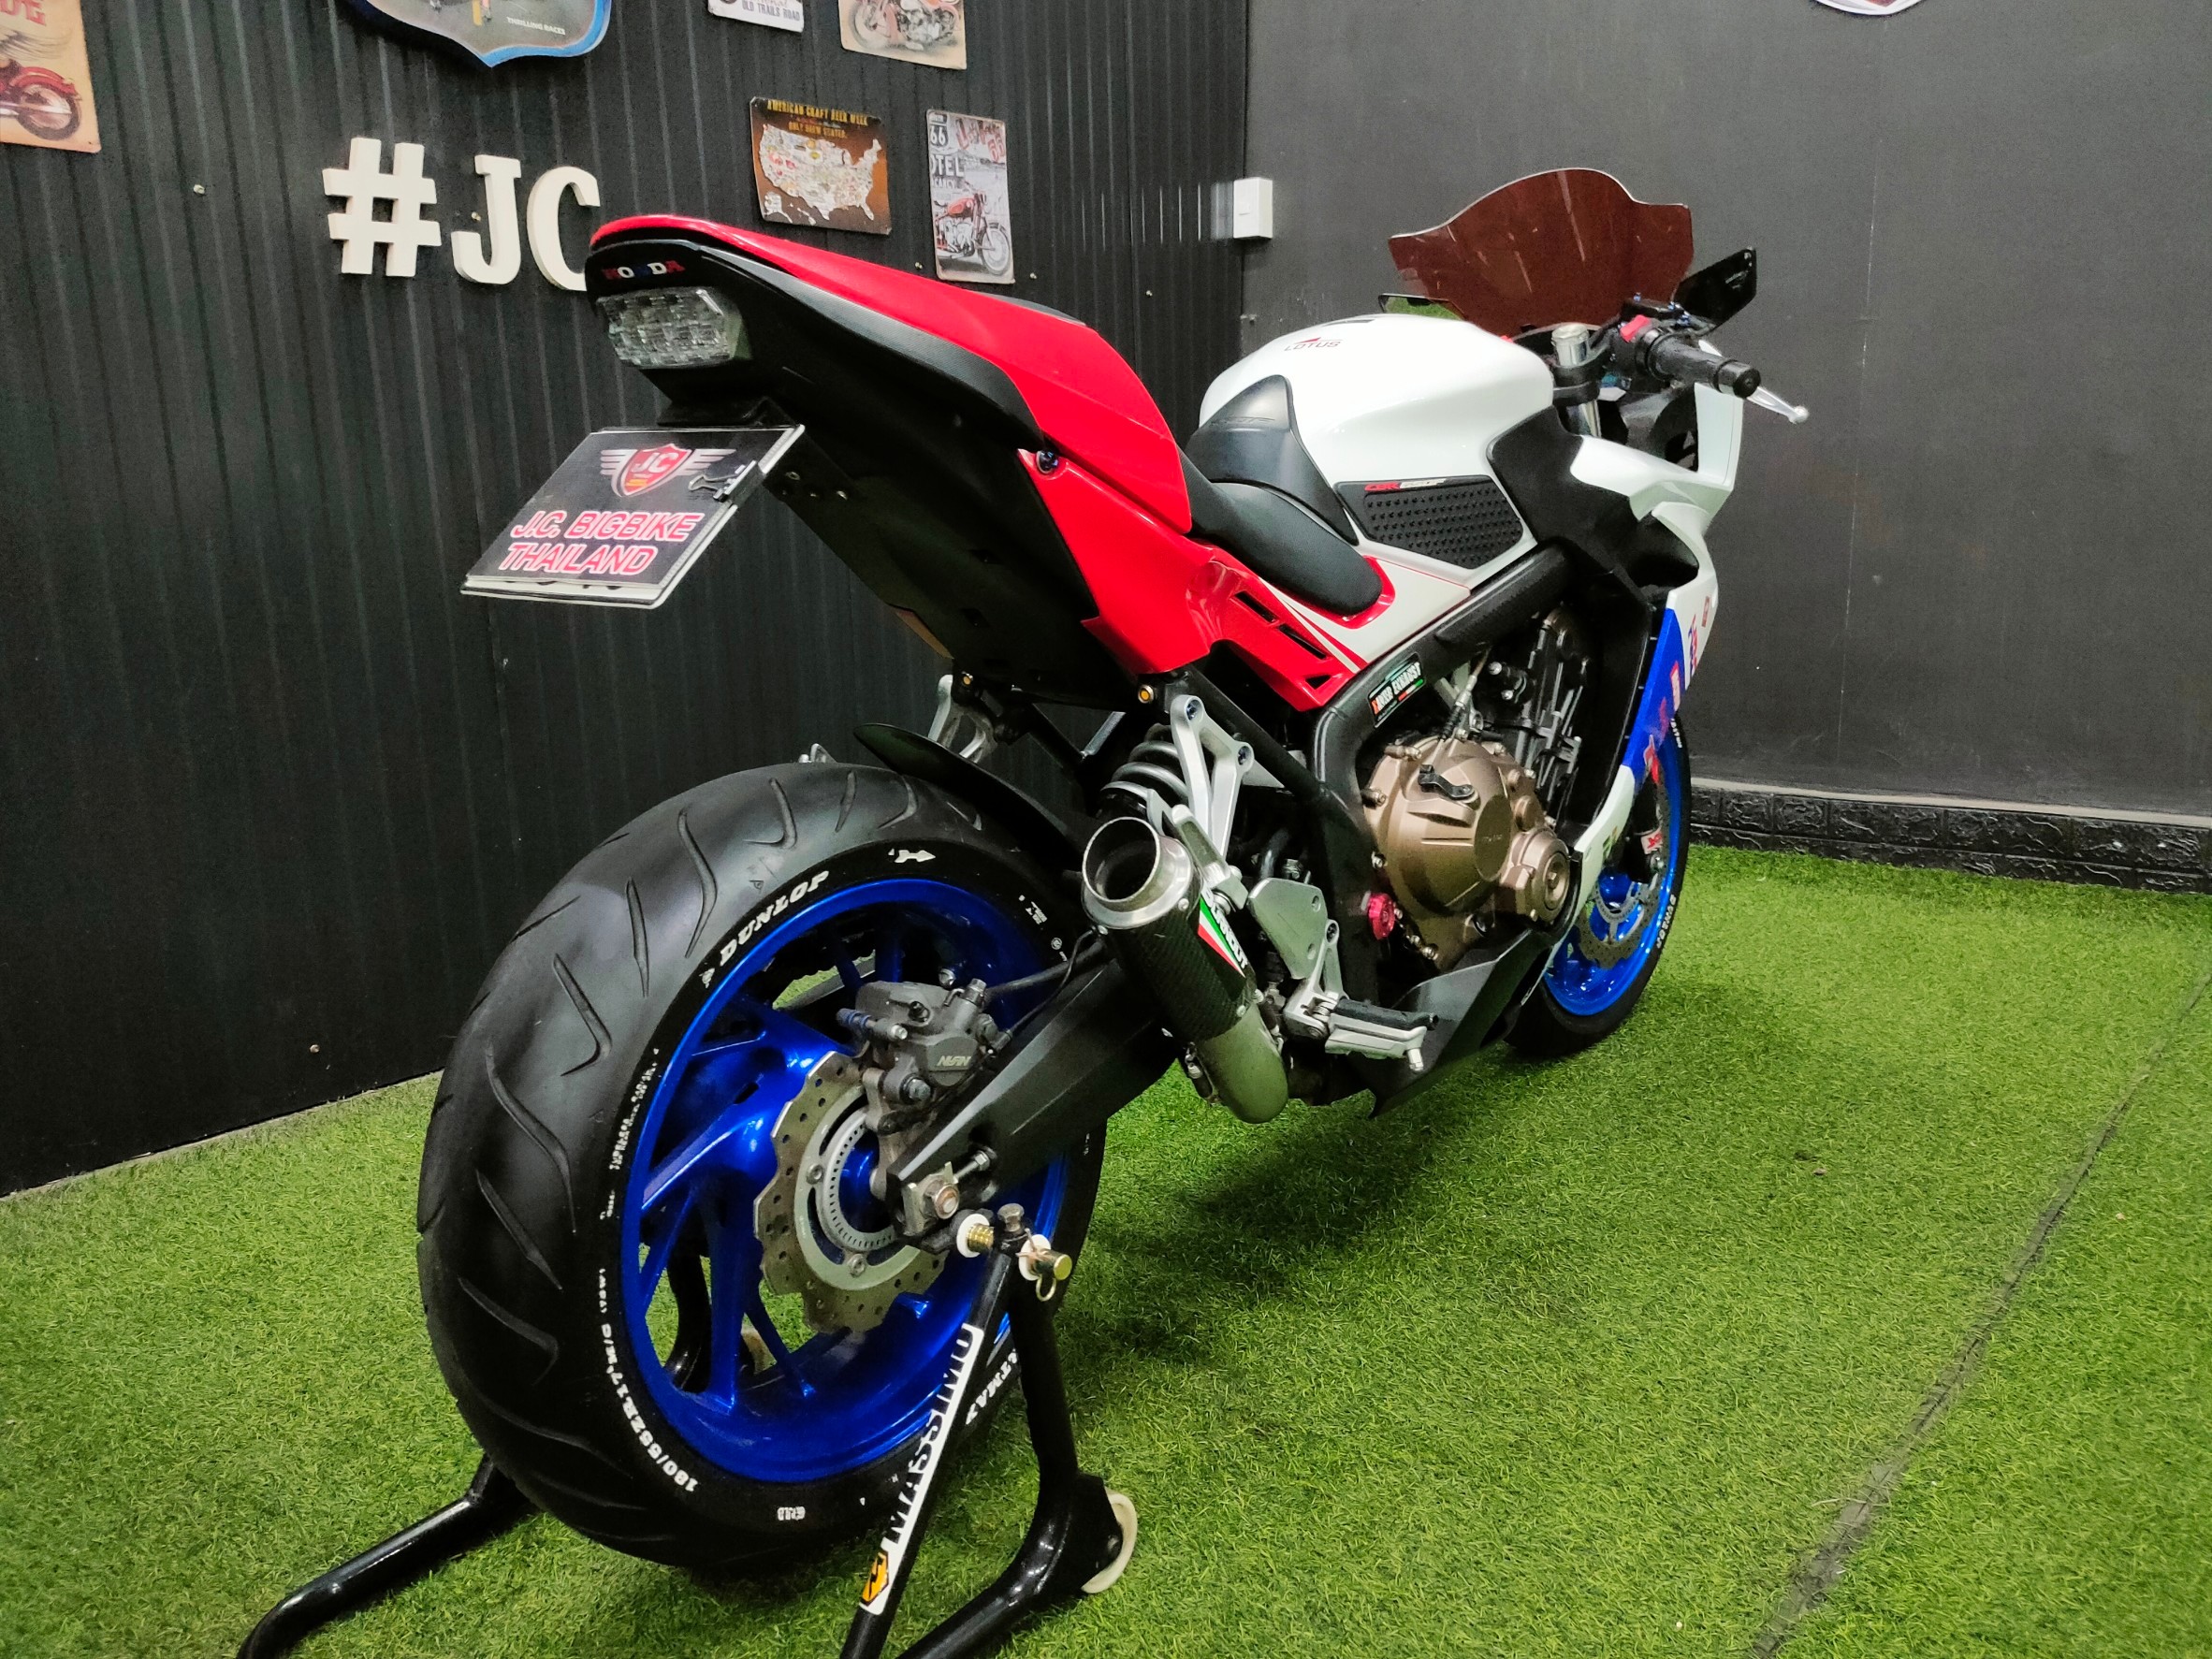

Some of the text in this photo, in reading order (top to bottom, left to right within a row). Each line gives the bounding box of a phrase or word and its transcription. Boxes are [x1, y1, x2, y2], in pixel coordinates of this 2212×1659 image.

[758, 3, 779, 17] TRAILS
[783, 8, 800, 21] ROAD
[767, 99, 805, 115] AMERICAN
[806, 106, 828, 119] CRAFT
[930, 125, 947, 146] 66
[987, 133, 1005, 161] 66
[602, 260, 686, 280] HONDA
[1284, 342, 1341, 352] LOTUS
[632, 452, 679, 473] JC
[564, 511, 705, 542] BIGBIKE
[499, 543, 658, 575] THAILAND
[720, 870, 829, 967] DUNLOP
[884, 1325, 975, 1546] MASSIMO
